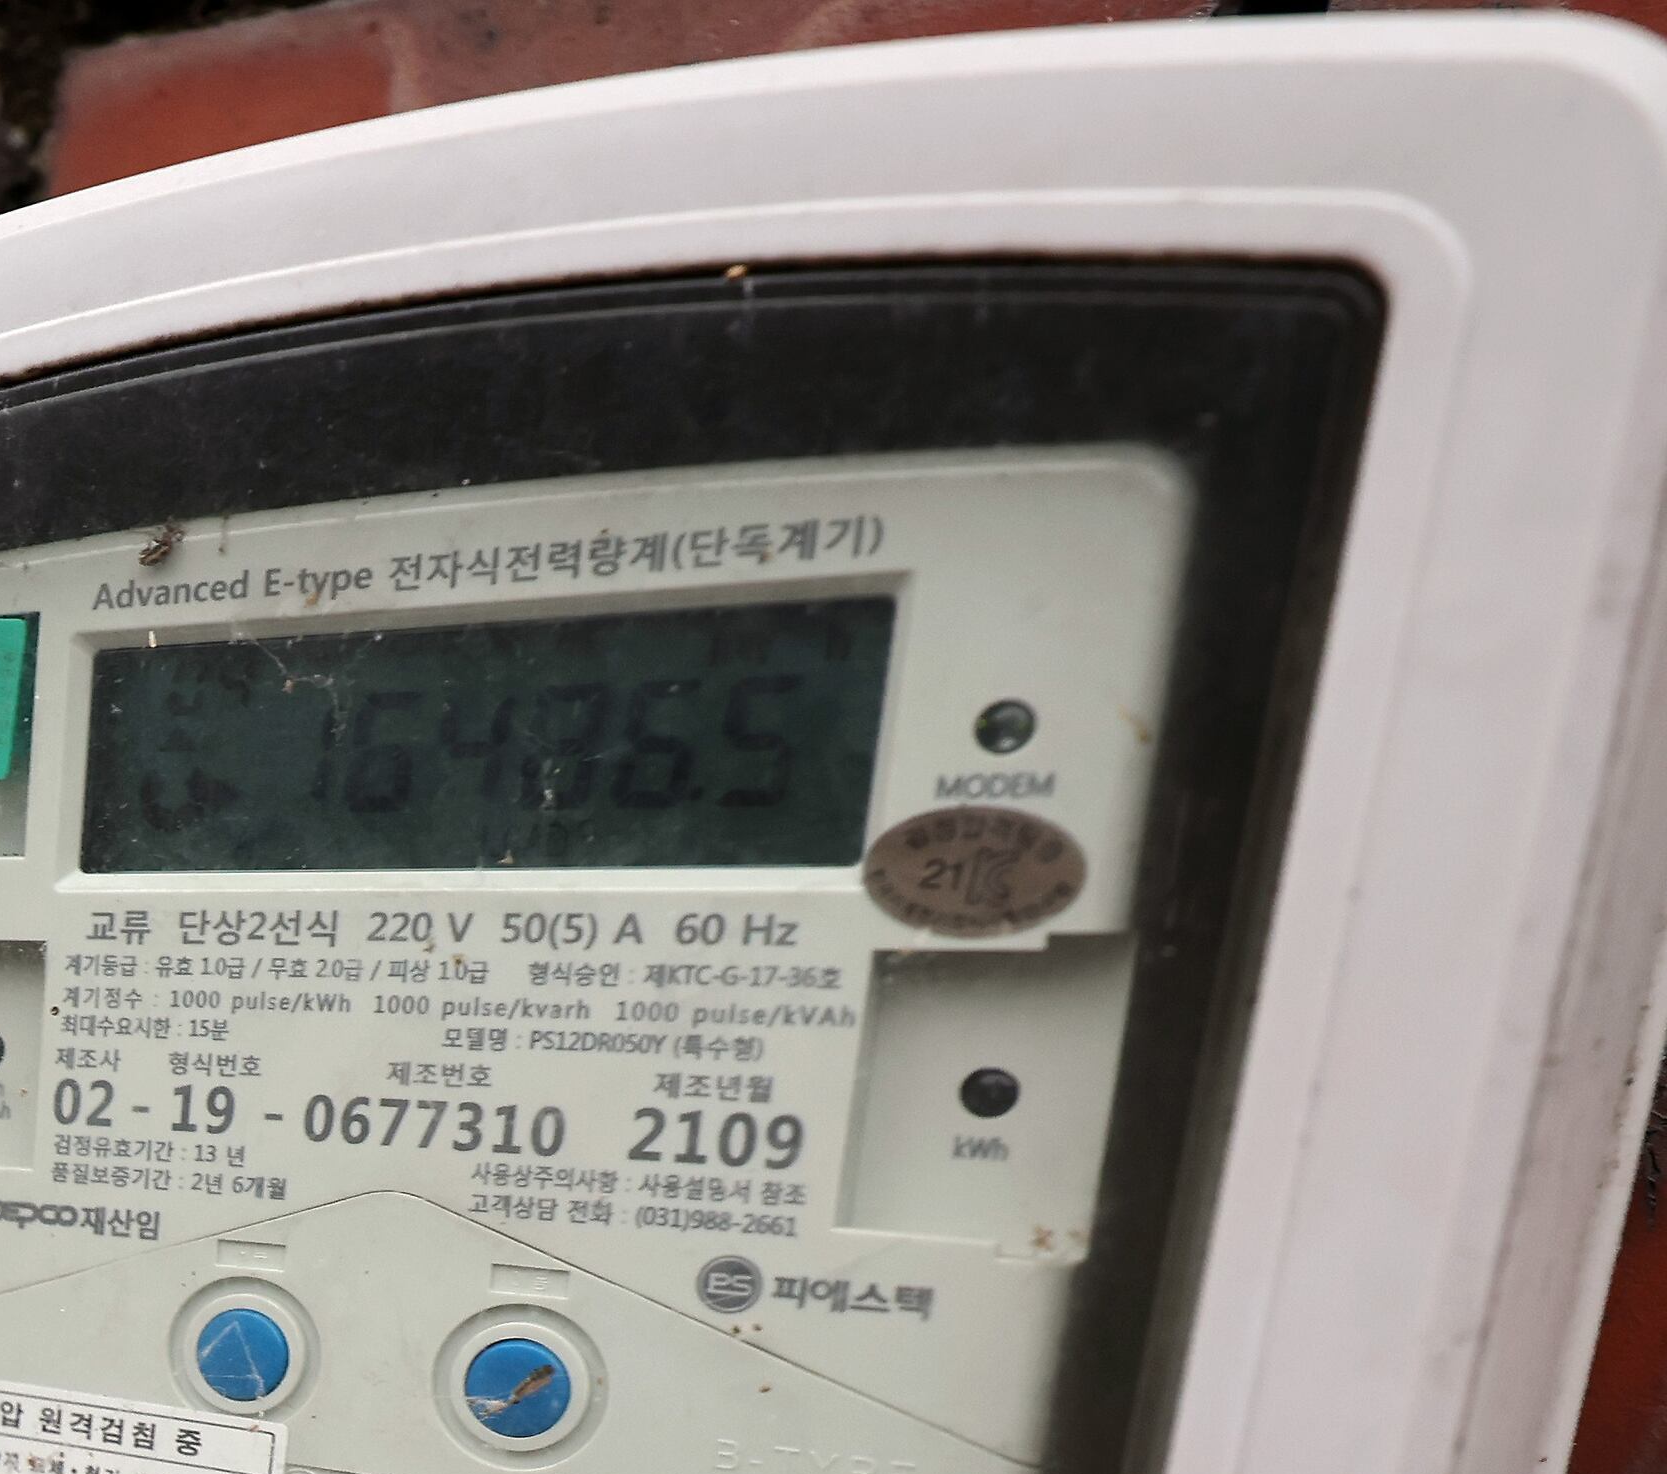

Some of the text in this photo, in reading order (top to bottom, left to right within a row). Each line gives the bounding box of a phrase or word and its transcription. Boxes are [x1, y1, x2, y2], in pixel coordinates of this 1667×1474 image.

[92, 570, 249, 610] Advanced
[263, 566, 373, 600] E-type
[935, 772, 1056, 801] MODEM
[85, 909, 799, 950] 교류 단상2선식 220 V 50(5) A 60 Hz
[64, 954, 138, 978] 계기등급
[155, 955, 194, 979] 유효
[387, 960, 430, 984] 피상
[529, 961, 619, 987] 형식승인
[170, 990, 221, 1008] 1000
[231, 991, 351, 1014] pulse/kWh
[374, 995, 430, 1015] 1000
[441, 997, 591, 1021] pulse/kvarh
[616, 1001, 679, 1022] 1000
[692, 1003, 856, 1028] pulse/kVAh
[189, 1019, 229, 1041] 15분
[55, 1047, 121, 1072] 제조사
[169, 1051, 262, 1077] 형식번호
[386, 1061, 492, 1088] 제조번호
[652, 1071, 775, 1103] 제조년월
[53, 1078, 114, 1127] 02
[170, 1084, 235, 1135] 19
[303, 1093, 566, 1157] 0677310
[627, 1106, 804, 1170] 2109
[53, 1134, 174, 1163] 검정유효기간
[194, 1144, 217, 1162] 13
[227, 1145, 245, 1168] 년
[951, 1136, 1009, 1162] kWh
[51, 1161, 172, 1190] 품질보증기간
[191, 1172, 223, 1195] 2년
[232, 1175, 288, 1201] 6개월
[635, 1206, 797, 1237] (031)988-2661
[772, 1276, 935, 1322] 피에스텍
[39, 1404, 156, 1451] 원격검침
[175, 1427, 203, 1457] 중
